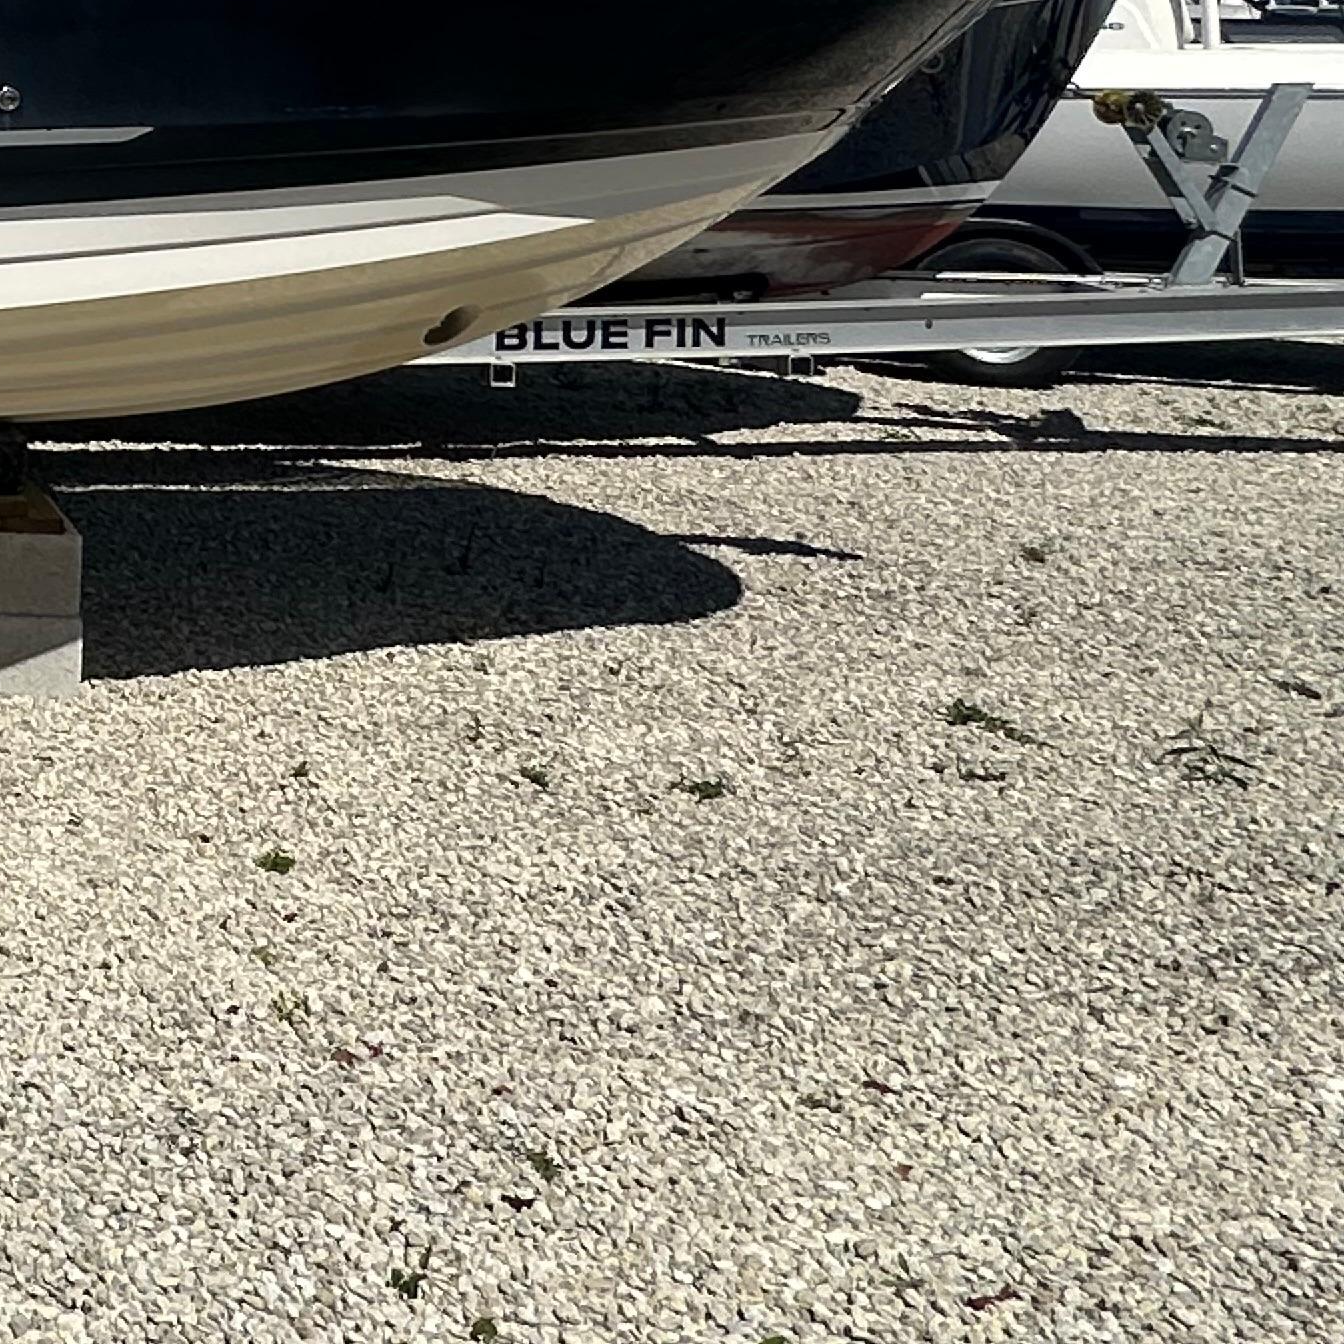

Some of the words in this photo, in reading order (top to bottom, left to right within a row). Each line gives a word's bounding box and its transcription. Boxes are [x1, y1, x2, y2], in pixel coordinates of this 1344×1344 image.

[494, 319, 629, 352] BLUE
[644, 317, 727, 349] FIN
[745, 331, 833, 348] TRAILERS
